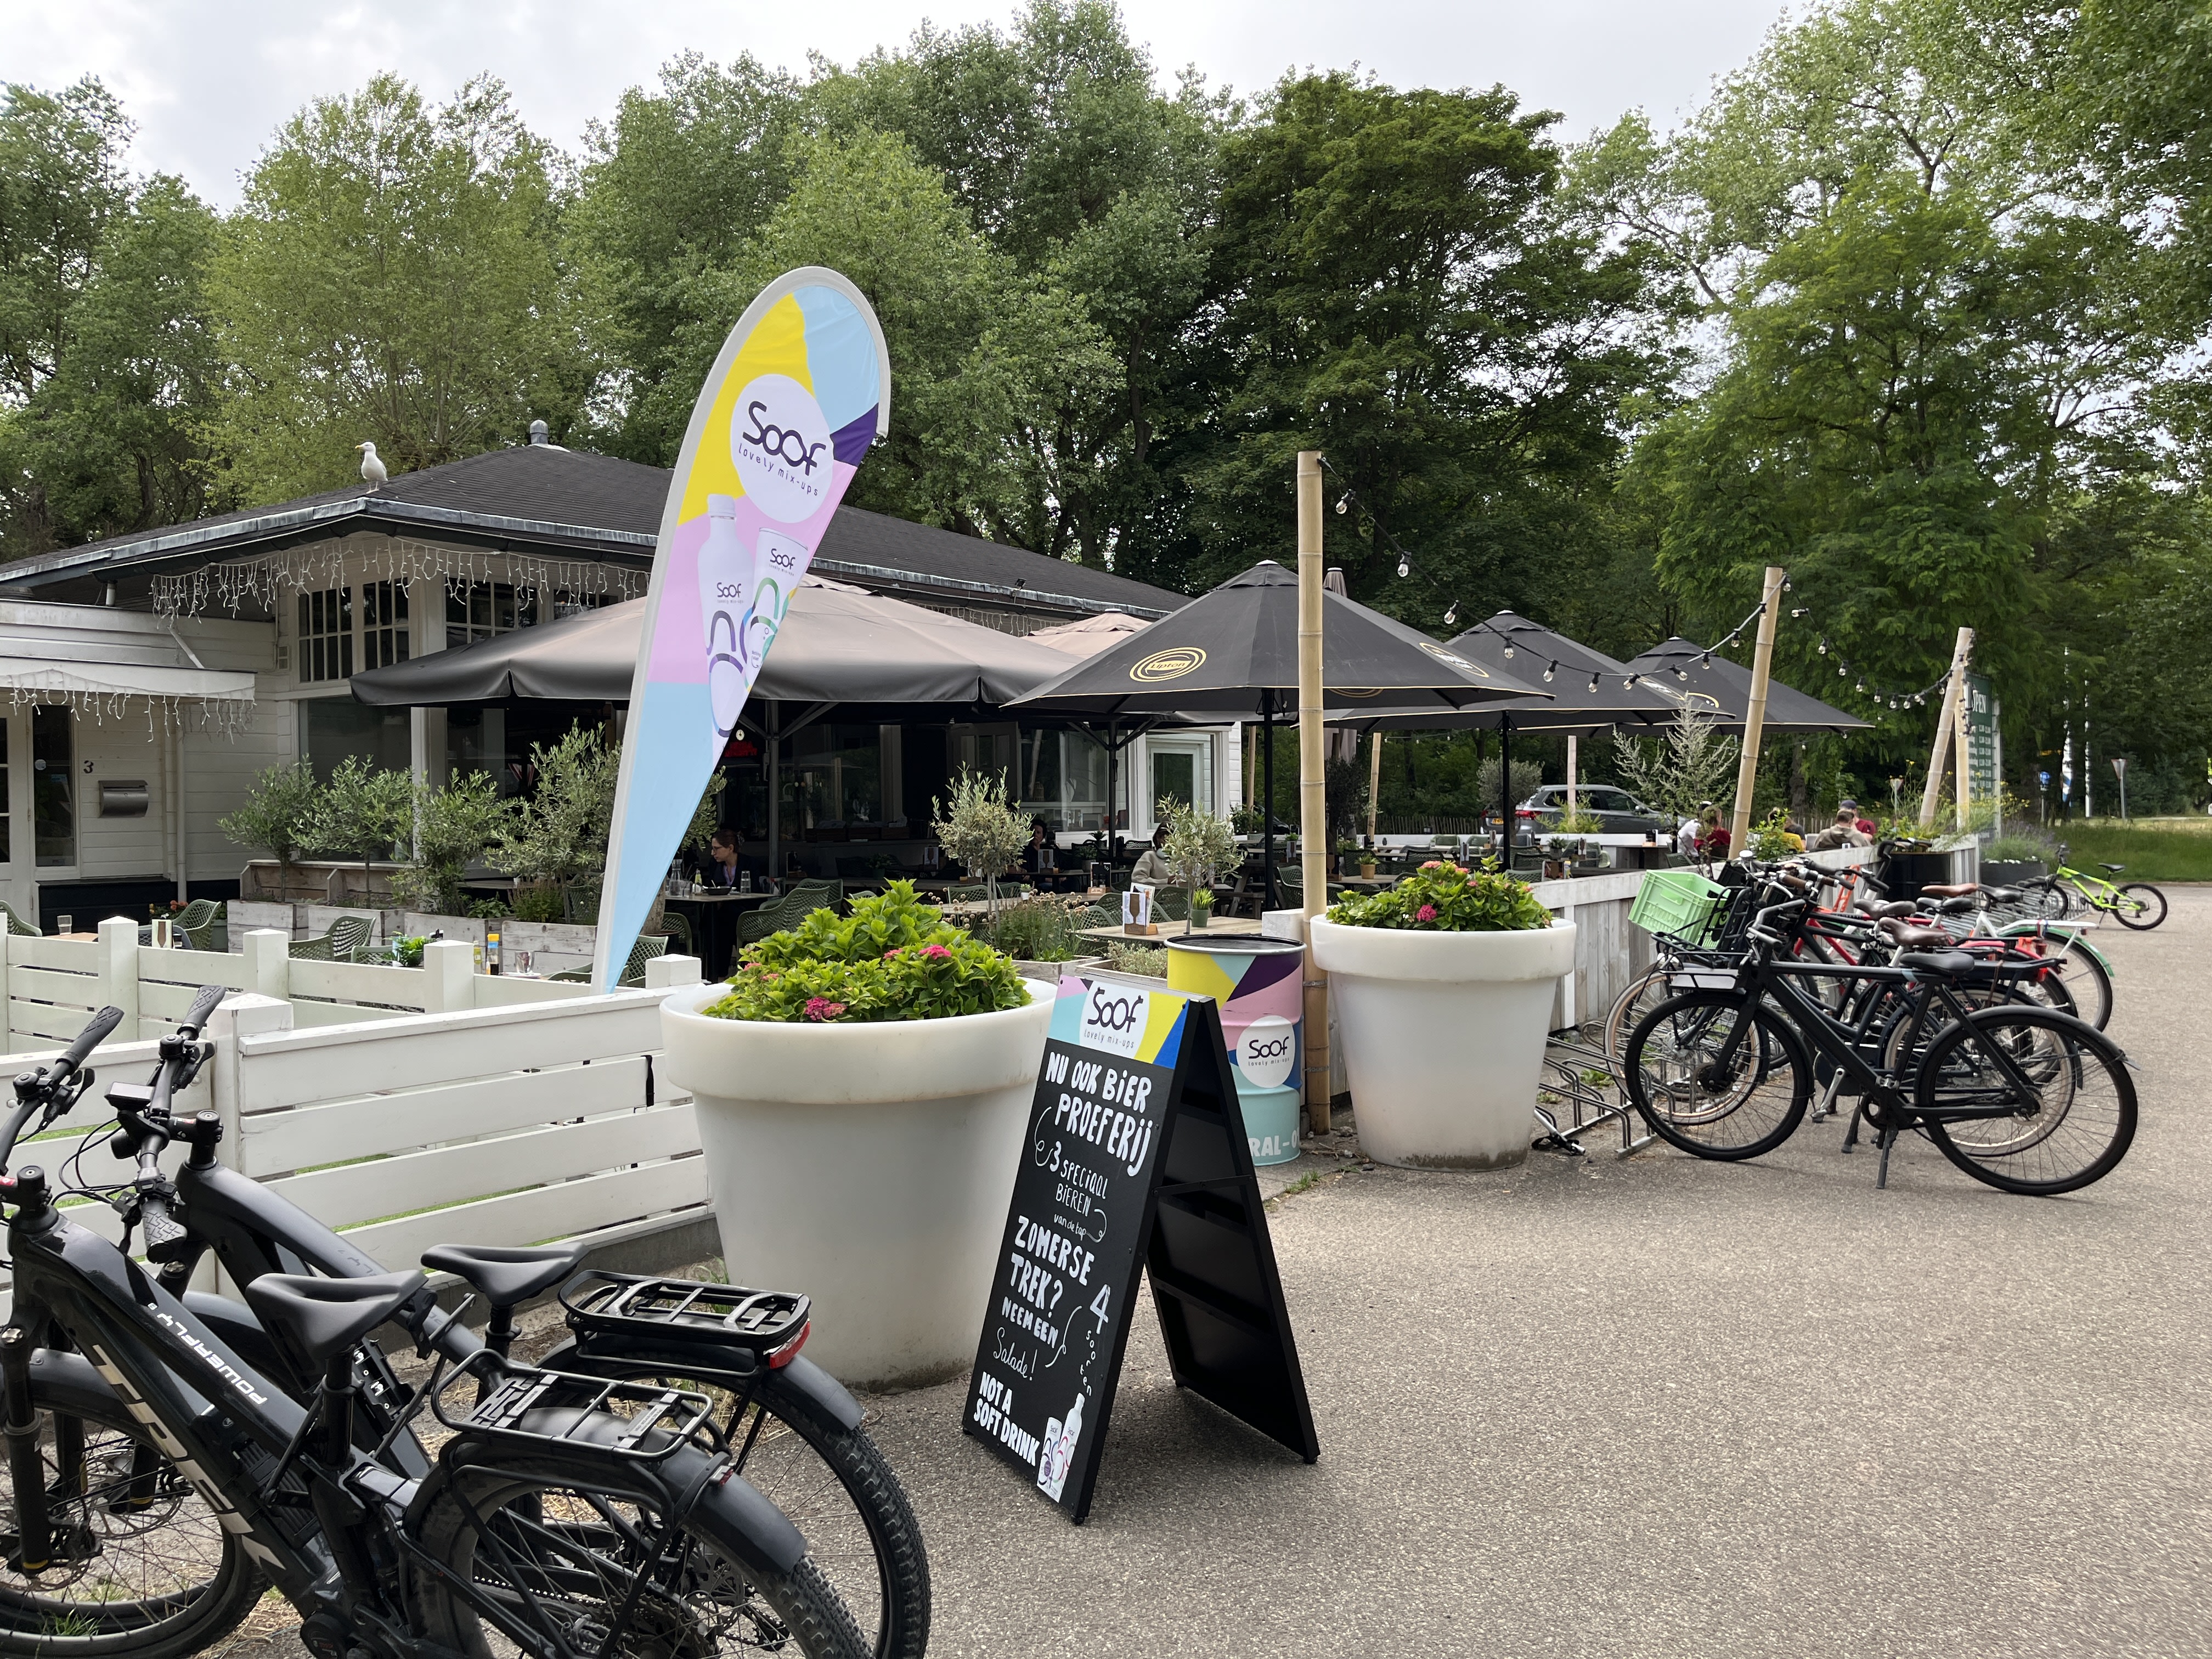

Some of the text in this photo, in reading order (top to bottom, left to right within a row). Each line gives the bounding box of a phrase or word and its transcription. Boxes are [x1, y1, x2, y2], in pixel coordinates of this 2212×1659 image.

[738, 443, 818, 496] lovely mix-ups
[83, 760, 94, 774] 3
[1084, 1029, 1135, 1049] lovely mix-ups
[1045, 1051, 1069, 1085] NU
[1071, 1060, 1102, 1094] OOK
[1049, 1141, 1062, 1172] 3
[1014, 1215, 1094, 1286] ZOMERSE
[1010, 1252, 1063, 1318] TREK?
[1090, 1284, 1111, 1334] 4
[157, 1313, 268, 1404] POWERFLY
[993, 1327, 1038, 1381] Salade!
[979, 1371, 1013, 1415] NOT A
[973, 1398, 1040, 1466] SOFT DRINK
